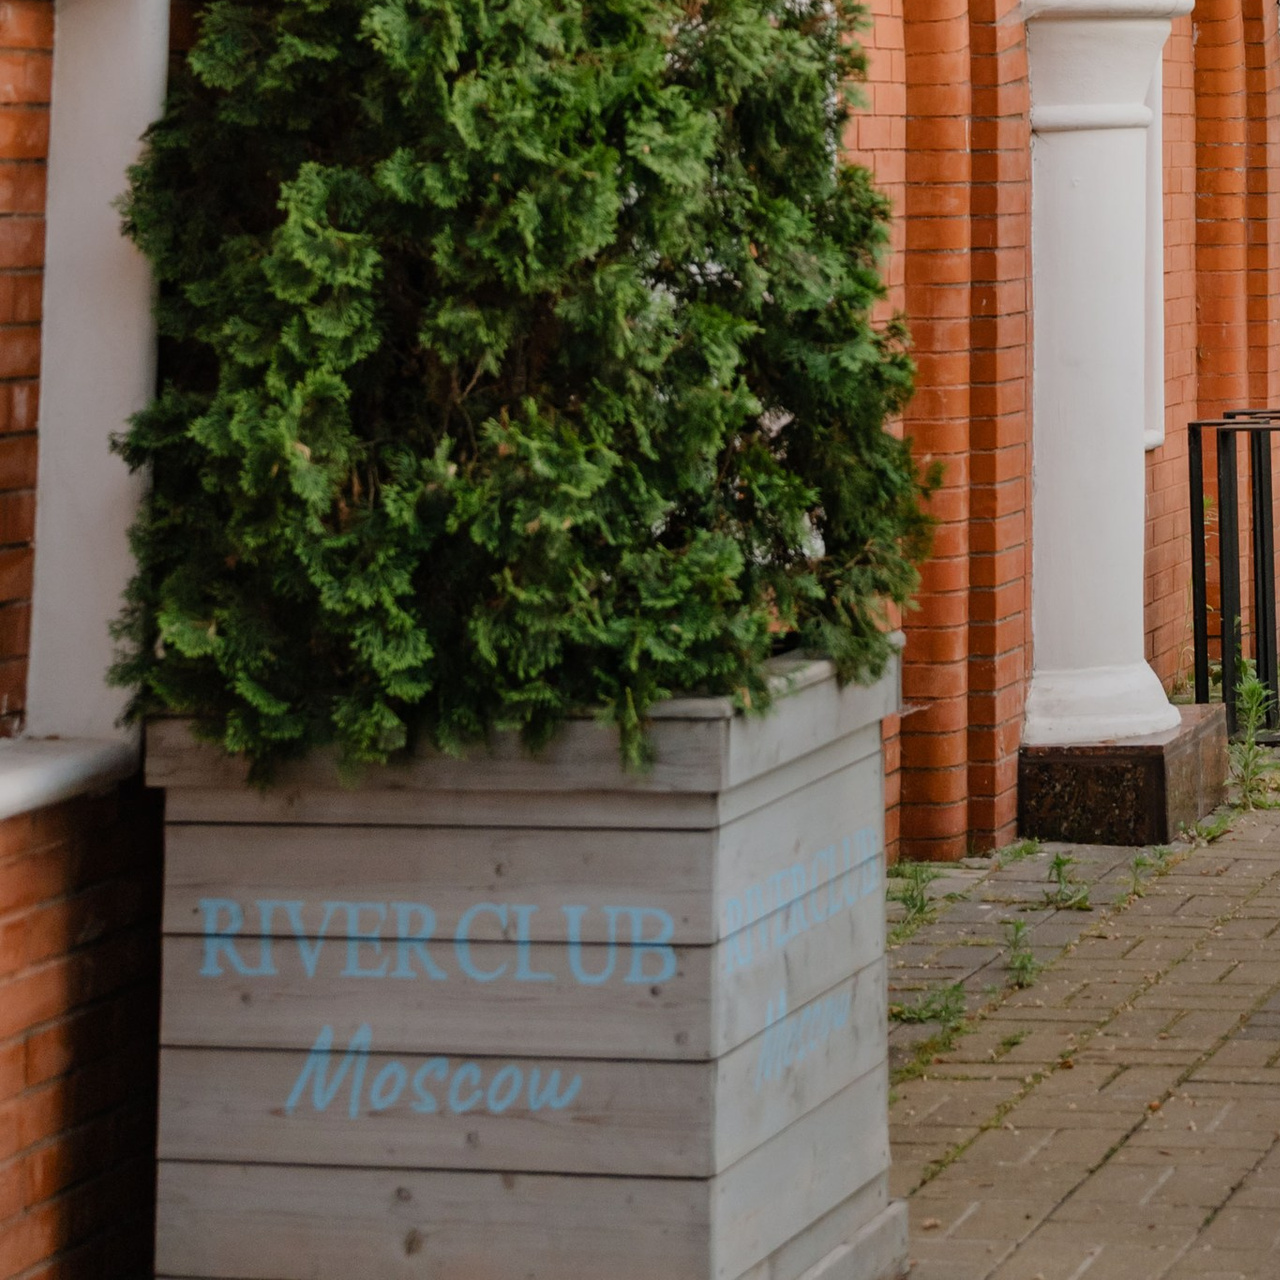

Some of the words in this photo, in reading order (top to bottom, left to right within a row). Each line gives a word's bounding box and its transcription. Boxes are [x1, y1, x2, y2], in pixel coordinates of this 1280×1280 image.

[199, 897, 449, 979] RIVER
[453, 902, 678, 985] CLUB
[285, 1022, 582, 1119] Moscow
